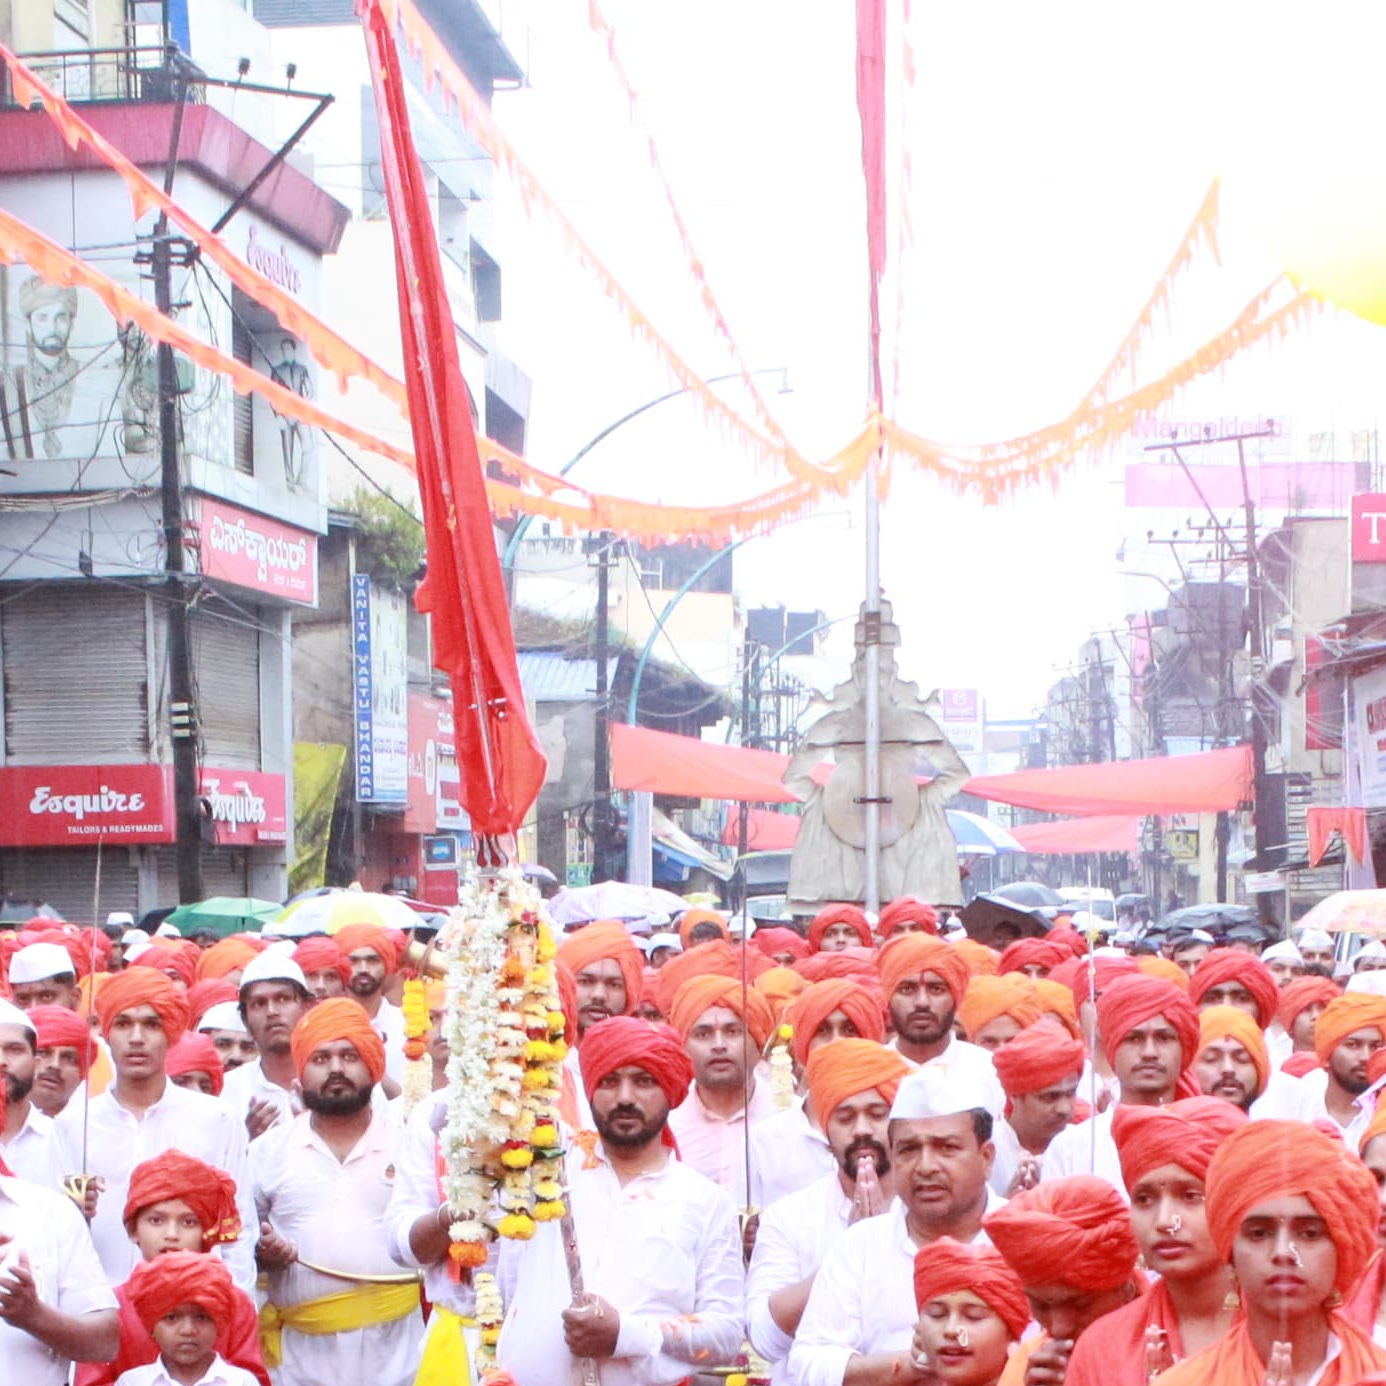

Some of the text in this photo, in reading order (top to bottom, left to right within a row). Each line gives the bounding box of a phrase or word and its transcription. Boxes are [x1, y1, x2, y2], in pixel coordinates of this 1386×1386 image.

[356, 578, 372, 797] VANITA VASTU BHANDAR
[29, 785, 145, 820] Esquire
[67, 825, 101, 835] TAILORS
[108, 824, 164, 834] READYMADES
